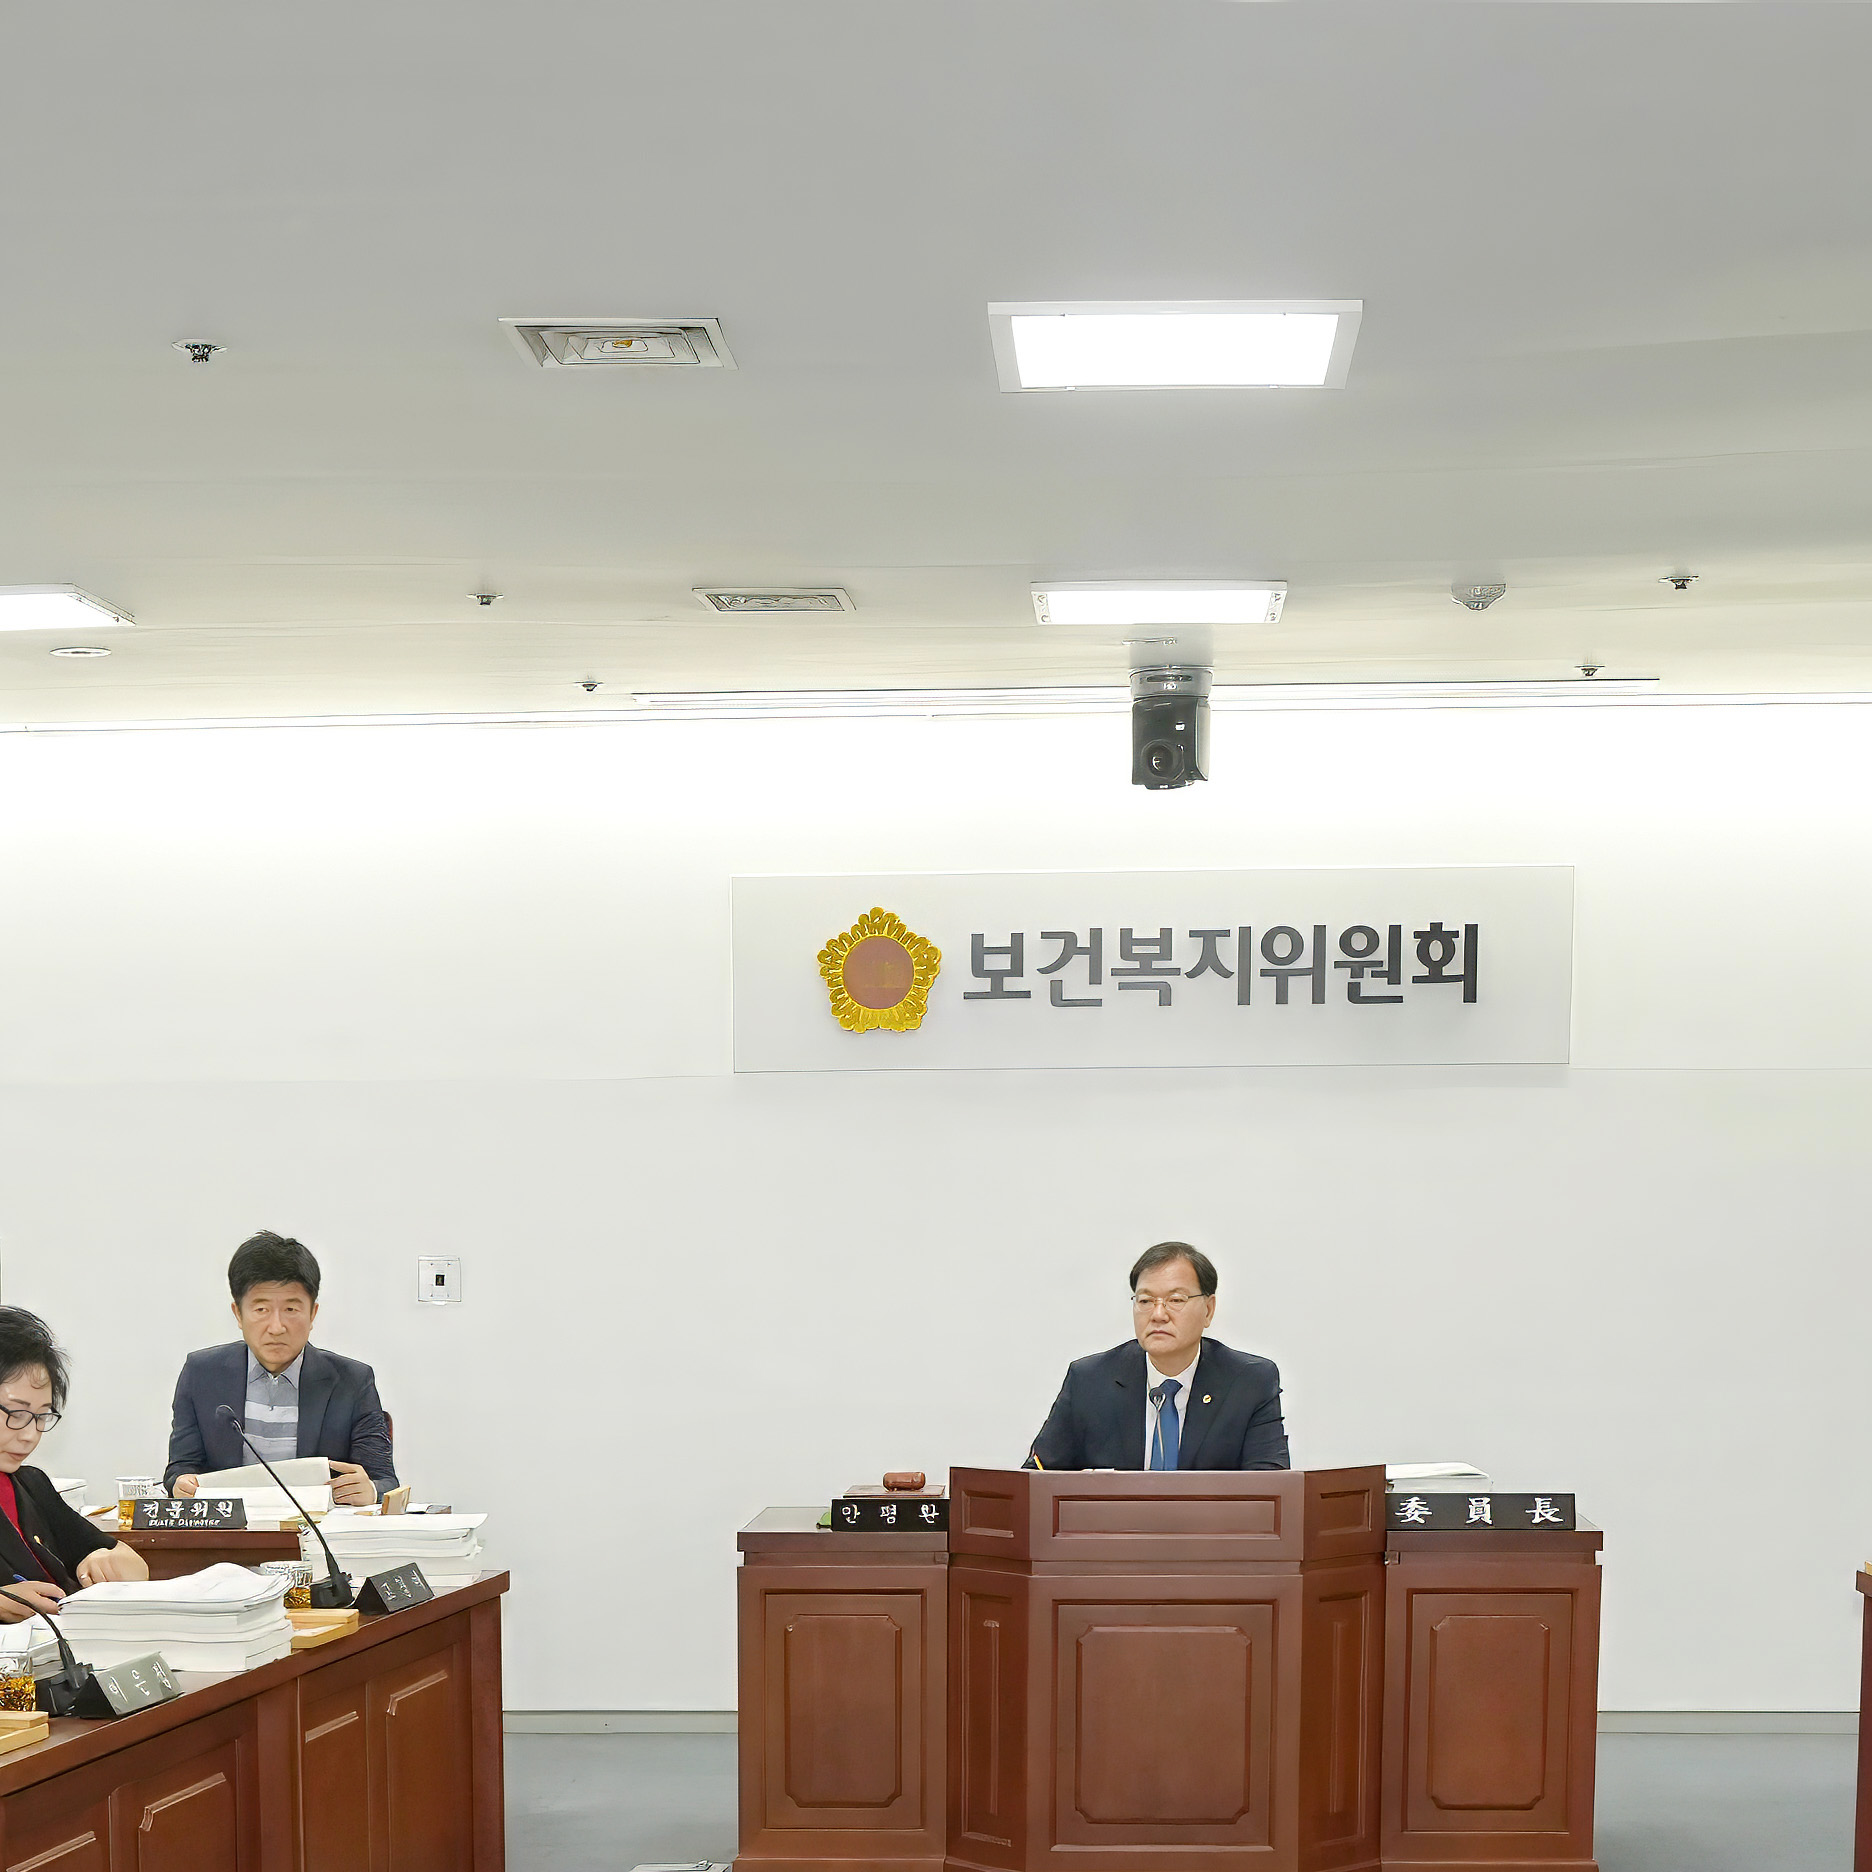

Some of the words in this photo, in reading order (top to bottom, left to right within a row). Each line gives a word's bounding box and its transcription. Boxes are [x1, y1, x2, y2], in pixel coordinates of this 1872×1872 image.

[964, 922, 1479, 1008] 보건복지위원회
[1395, 1496, 1564, 1525] 委員長
